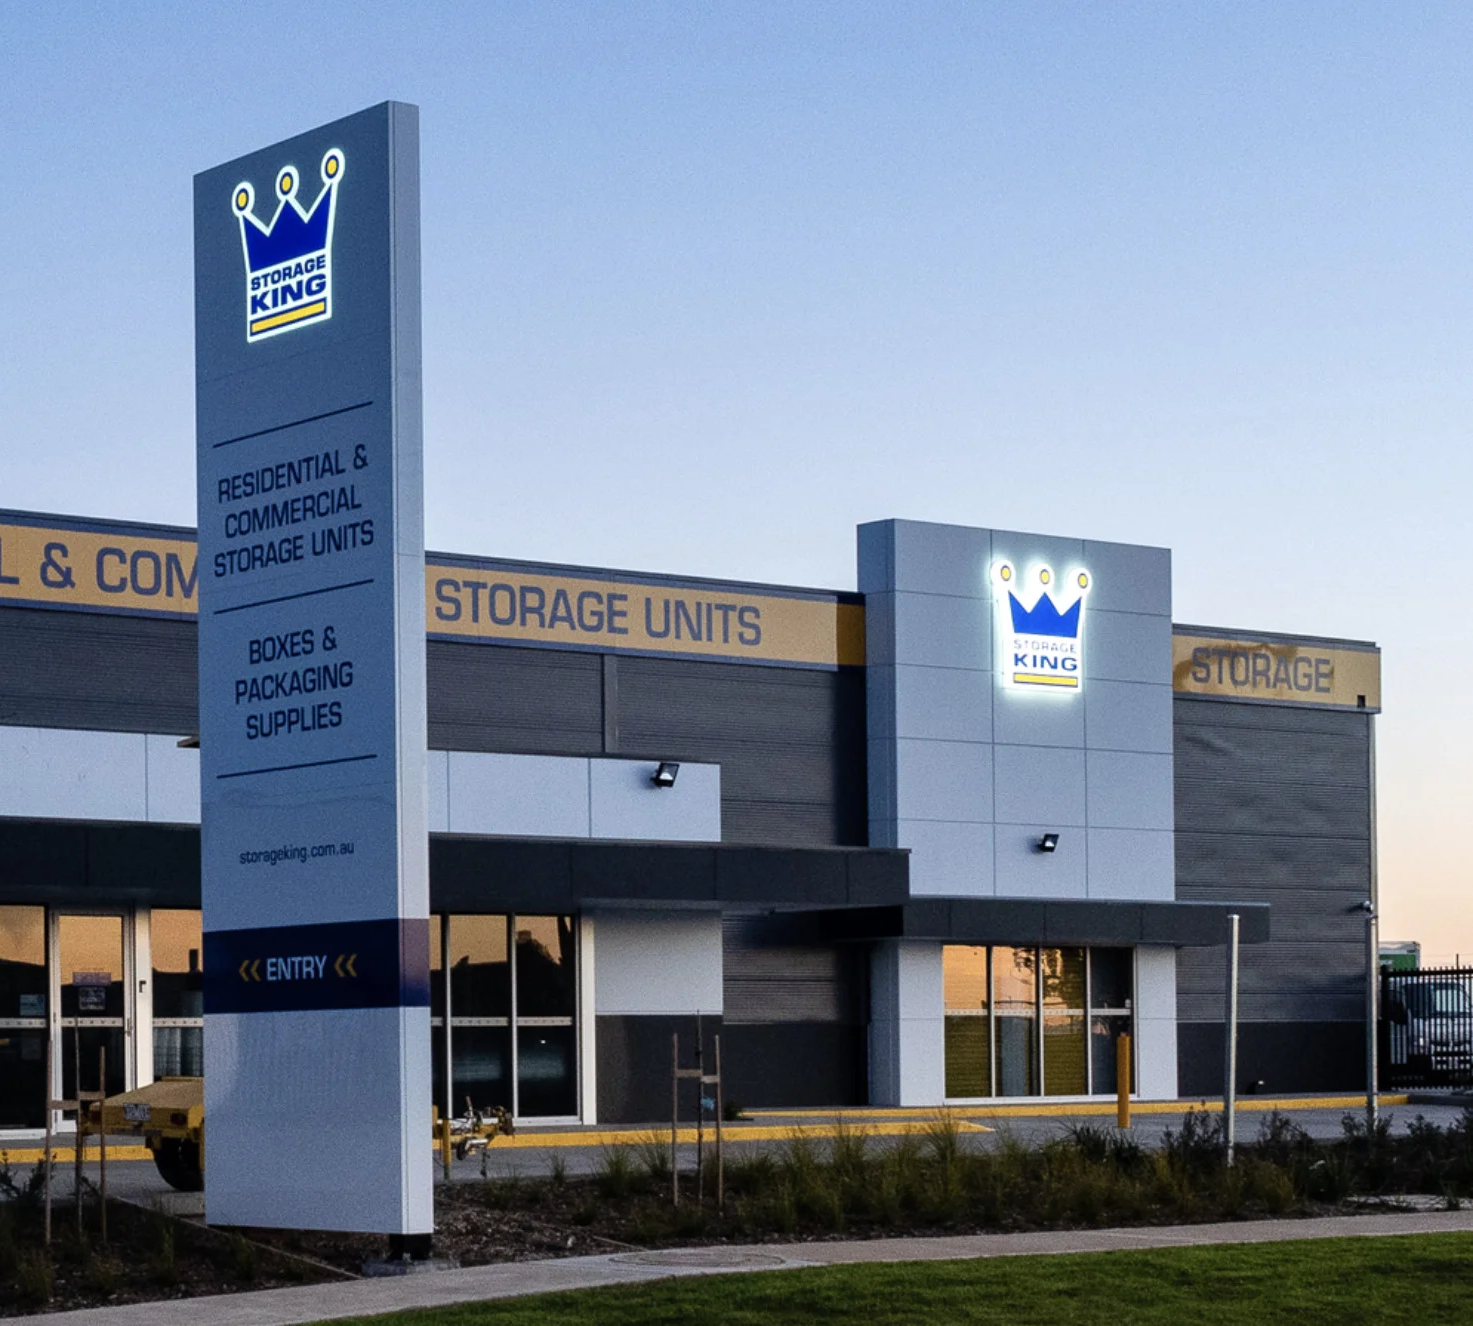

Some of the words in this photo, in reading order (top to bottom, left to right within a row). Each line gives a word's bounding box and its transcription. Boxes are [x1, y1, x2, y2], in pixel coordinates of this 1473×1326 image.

[250, 254, 326, 292] STORAGE
[250, 274, 326, 315] KING
[218, 449, 345, 504] RESIDENTIAL
[353, 444, 368, 470] &
[225, 484, 362, 539] COMMERCIAL
[39, 541, 76, 589] &
[214, 534, 304, 578] STORAGE
[311, 519, 375, 557] UNITS
[434, 577, 629, 635] STORAGE
[645, 596, 762, 647] UNITS
[249, 628, 315, 665] BOXES
[322, 625, 337, 651] &
[1013, 639, 1077, 654] STORAGE
[1013, 653, 1078, 672] KING
[235, 661, 354, 705] PACKAGING
[1190, 647, 1333, 694] STORAGE
[246, 701, 343, 741] SUPPLIES
[239, 841, 355, 866] storageking.com.au
[266, 955, 328, 981] ENTRY
